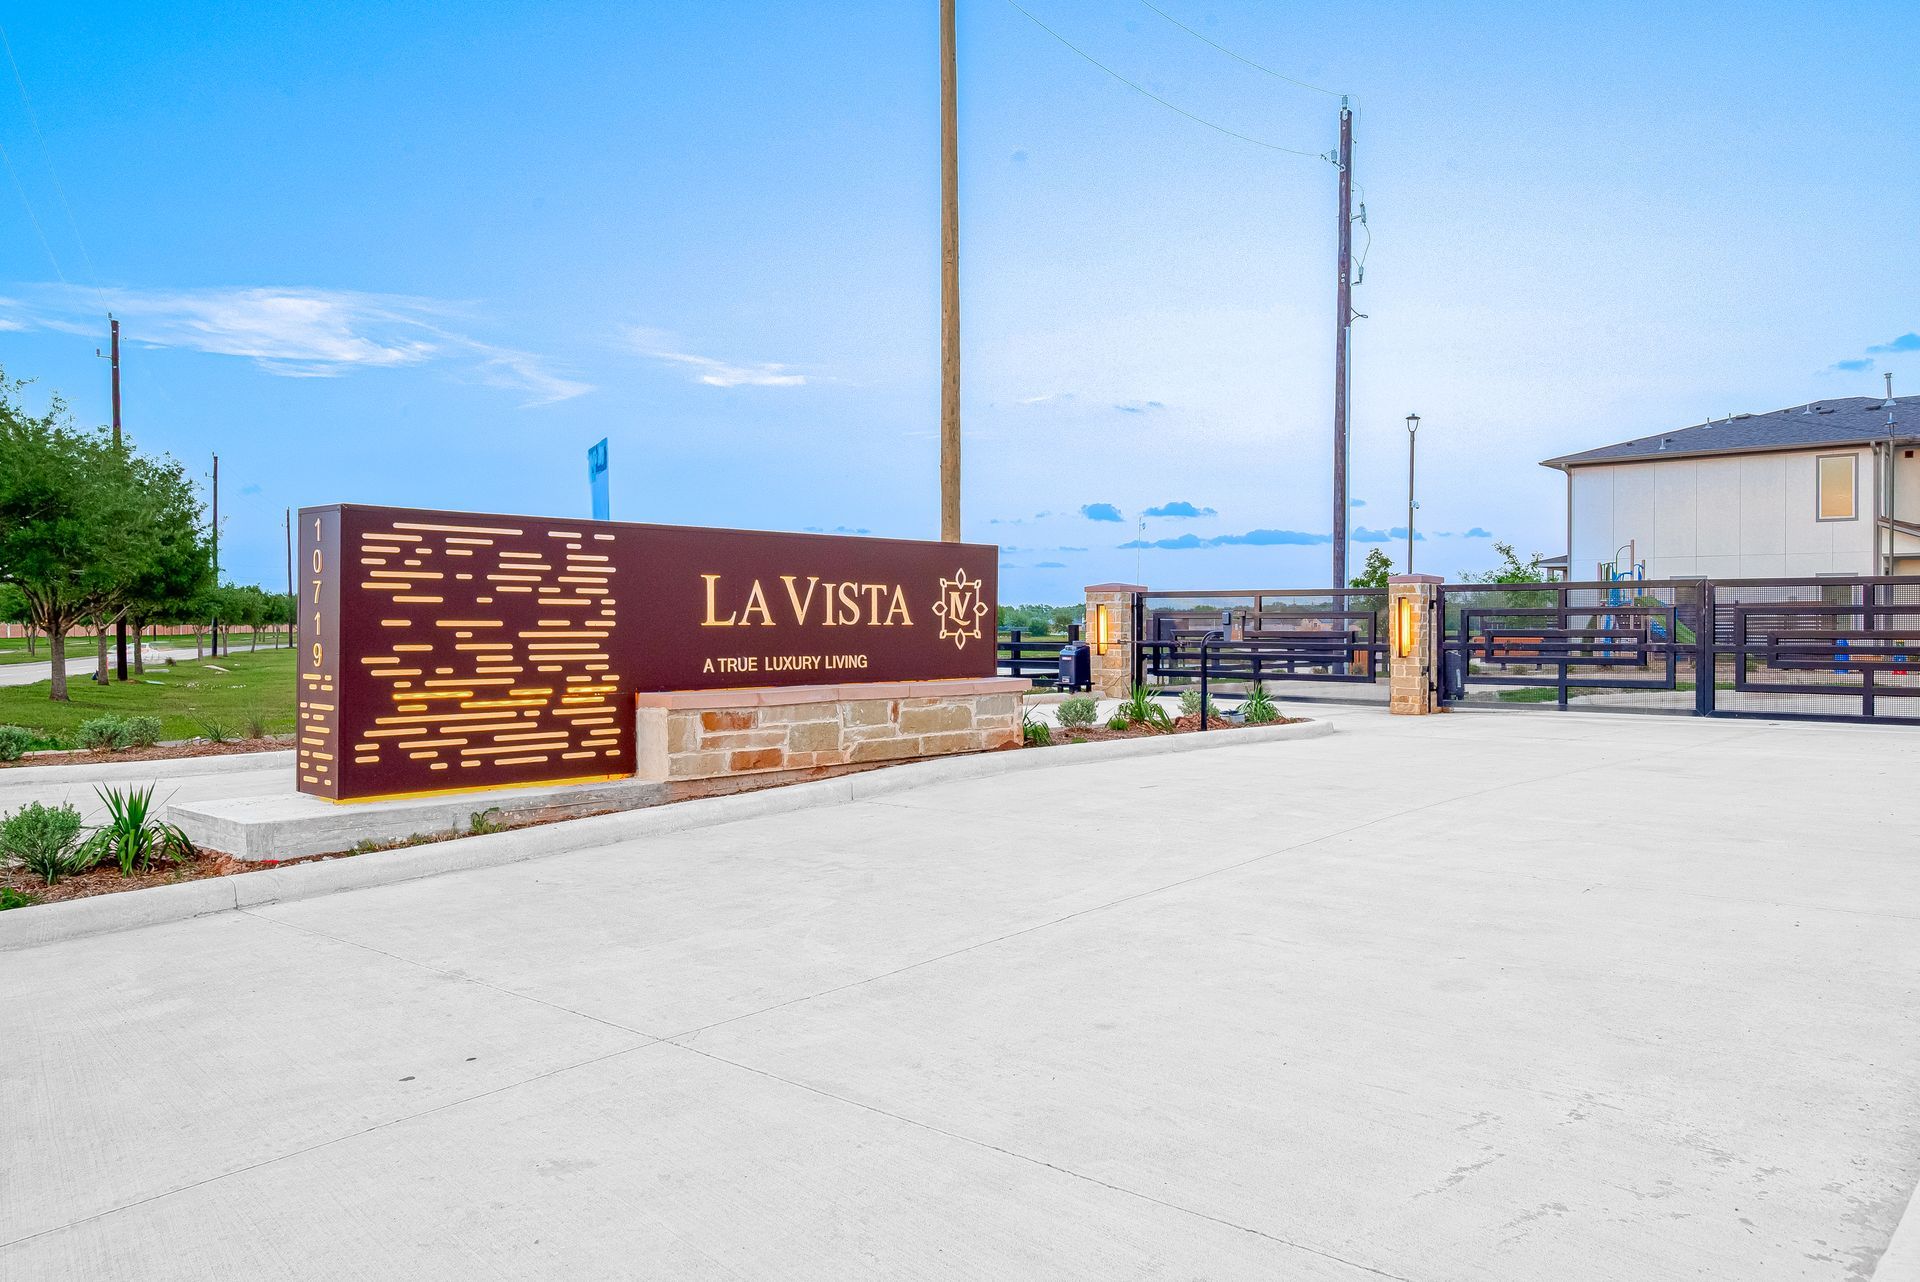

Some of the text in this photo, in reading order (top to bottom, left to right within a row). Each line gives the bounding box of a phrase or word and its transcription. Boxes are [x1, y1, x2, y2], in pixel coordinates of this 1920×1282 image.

[312, 518, 323, 667] 10719
[780, 575, 914, 626] VISTA
[703, 654, 868, 673] A TRUE LUXURY LIVING
